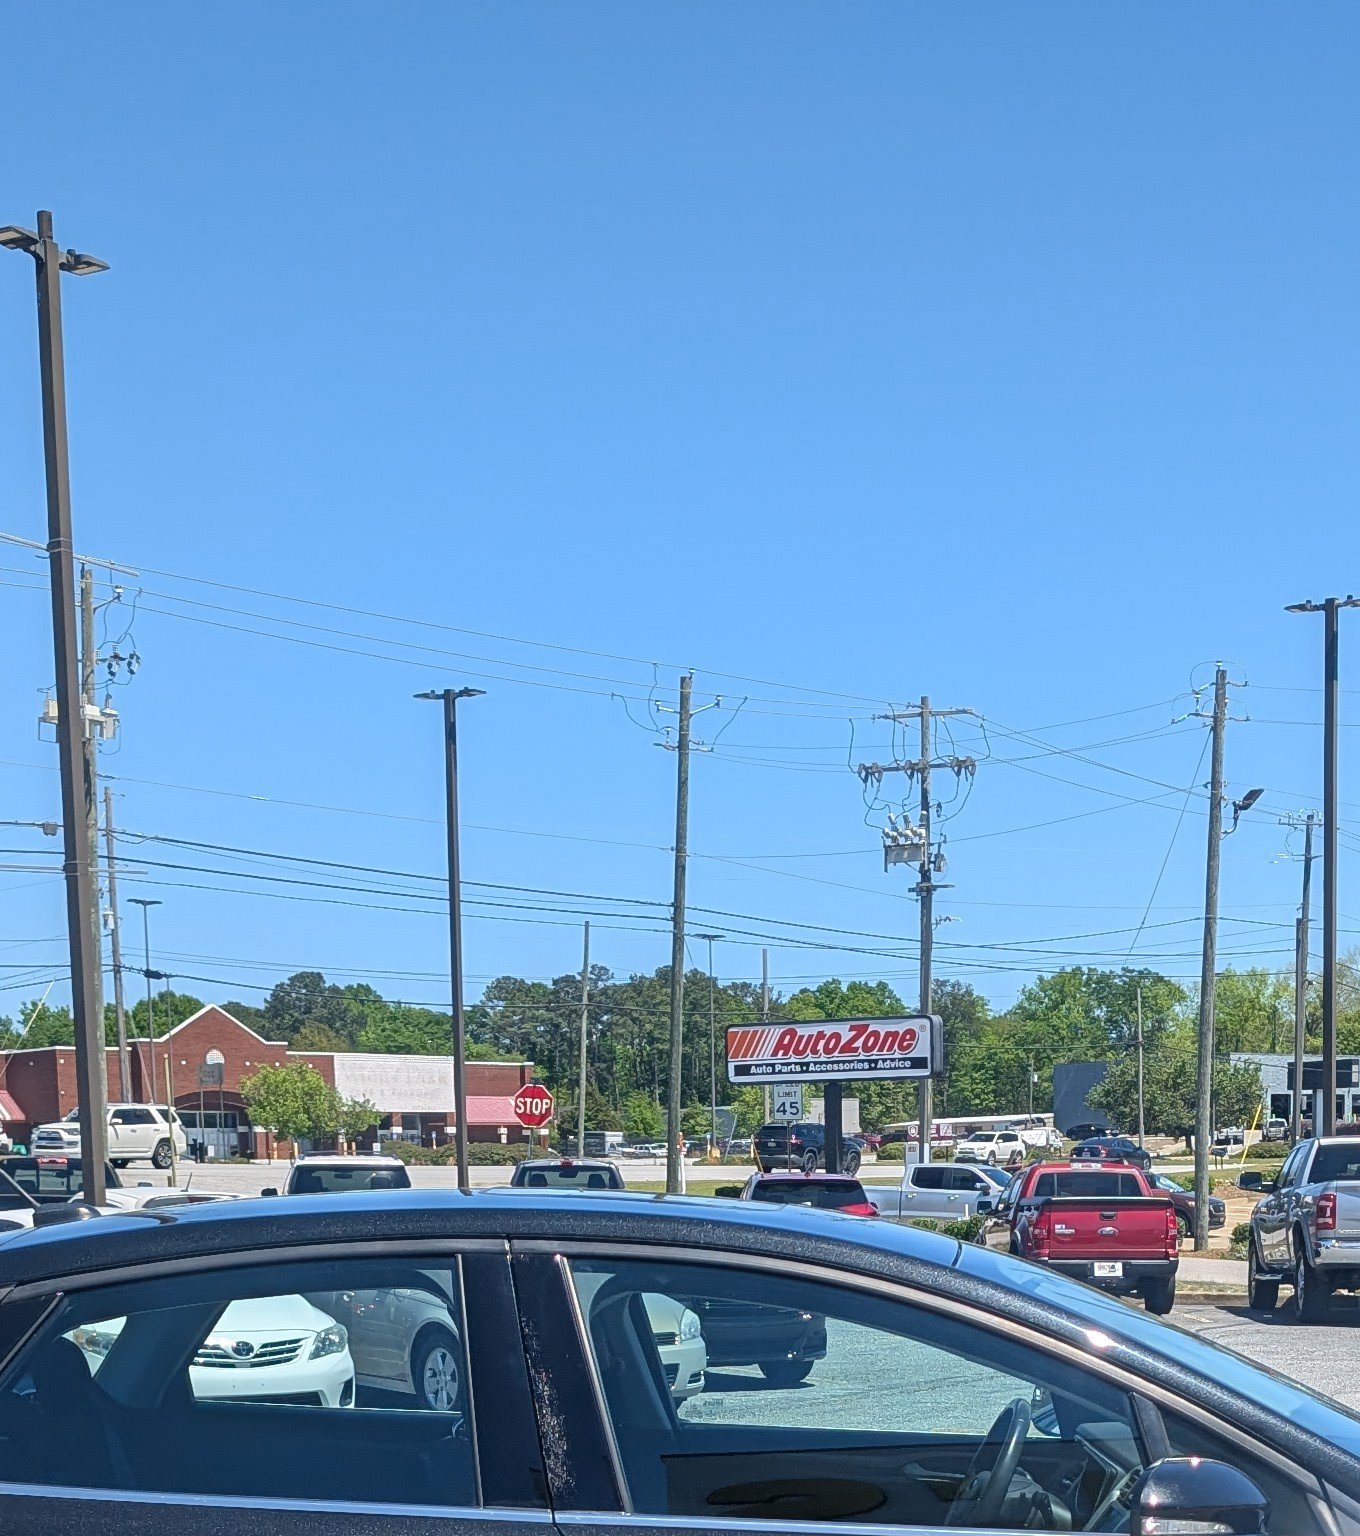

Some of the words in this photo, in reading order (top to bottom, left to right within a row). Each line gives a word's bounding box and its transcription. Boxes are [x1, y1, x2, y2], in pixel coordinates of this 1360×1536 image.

[770, 1024, 920, 1059] AutoZone
[750, 1065, 772, 1073] Auto
[774, 1063, 801, 1073] Parts
[809, 1061, 870, 1071] Accessories
[877, 1060, 911, 1069] Advice
[516, 1097, 551, 1115] STOP
[776, 1101, 800, 1116] 45
